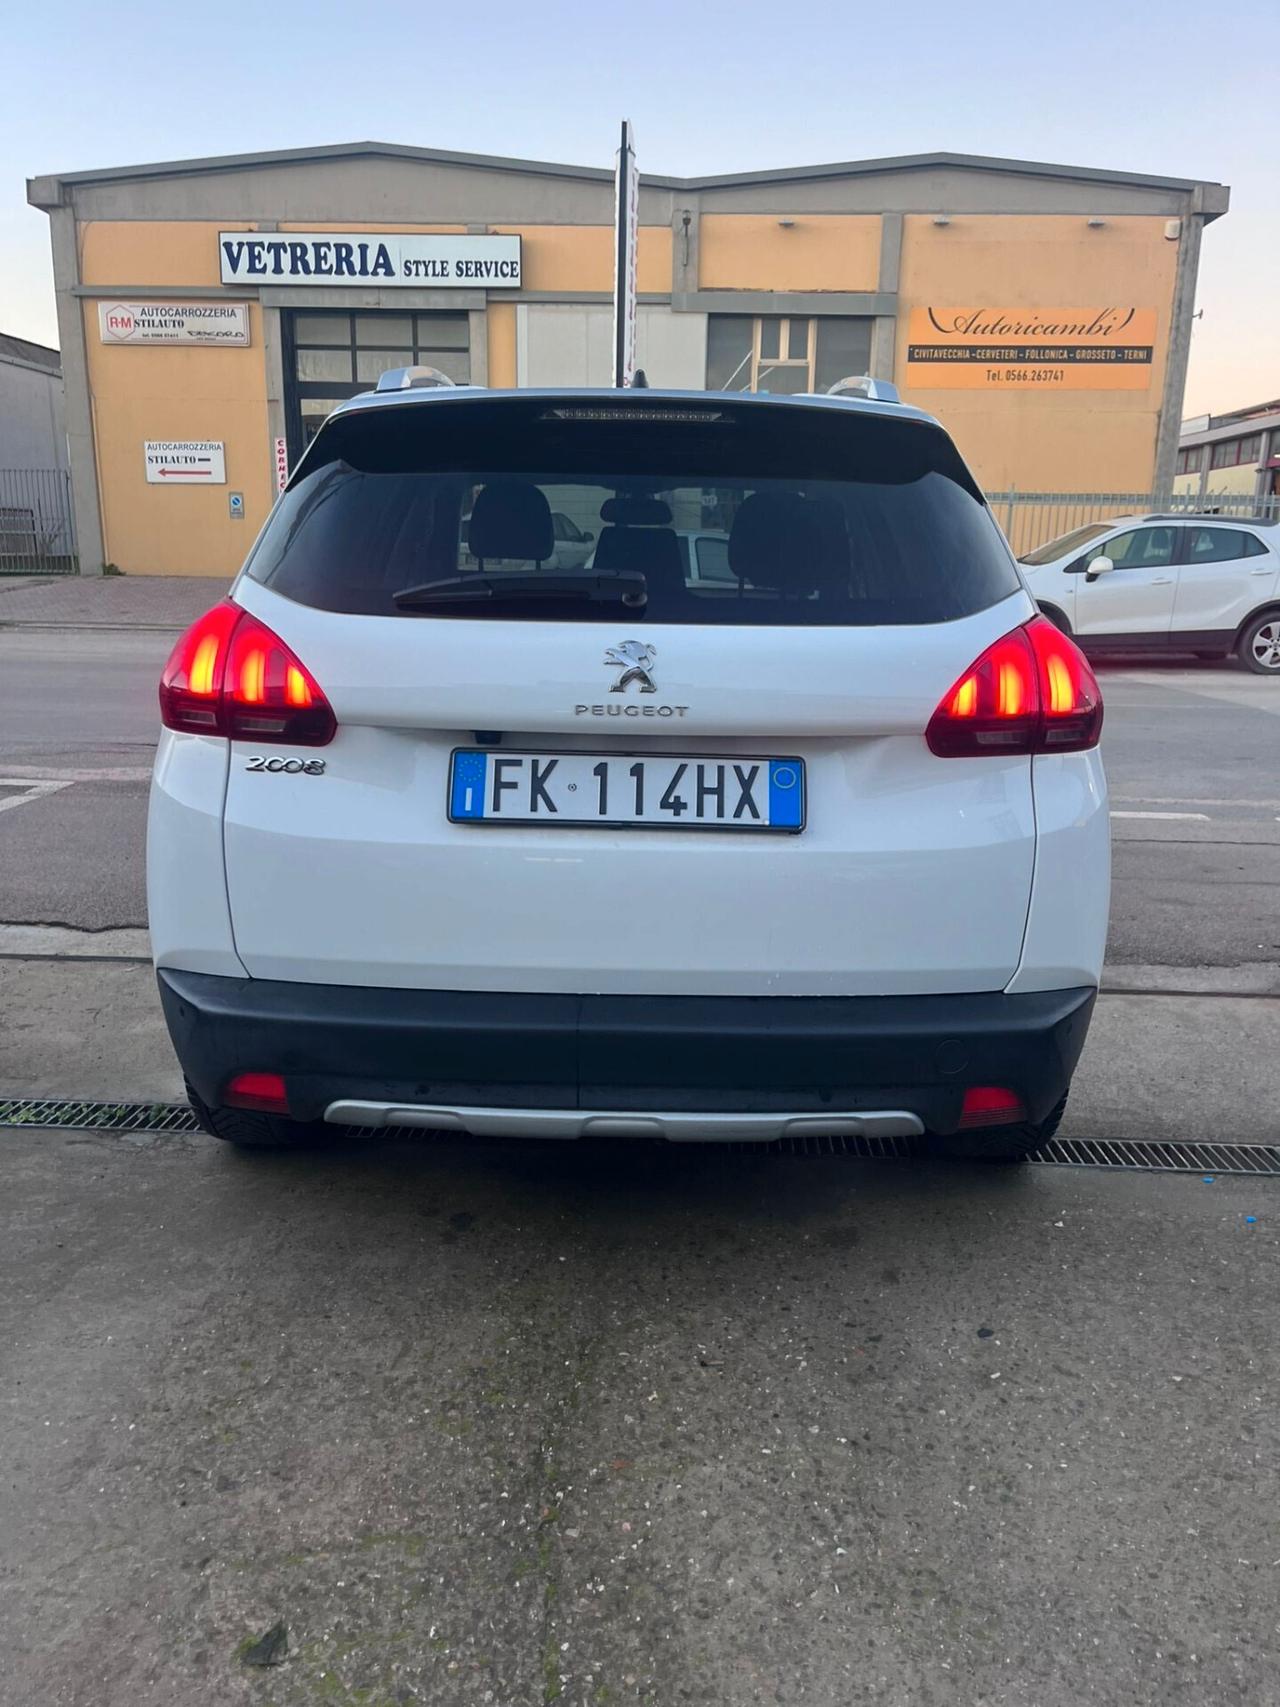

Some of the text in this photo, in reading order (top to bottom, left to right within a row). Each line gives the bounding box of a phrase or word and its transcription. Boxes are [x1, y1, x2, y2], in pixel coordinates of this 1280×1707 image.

[222, 241, 519, 279] VETRERIA STYLE SERVICE
[140, 307, 237, 318] AUTOCARROZZERIA
[134, 318, 185, 329] STILAUTO
[951, 307, 1119, 336] Autoricambi
[914, 348, 1147, 359] CIVITAVECCHIA CERVETERI FOLLONICA GROSSETO TERNI
[986, 369, 1064, 382] Tel. 0566.263741
[147, 443, 222, 451] AUTOCARROZZERIA
[147, 455, 196, 464] STILAUTO
[574, 704, 690, 717] PEUGEOT
[245, 756, 327, 776] 2008
